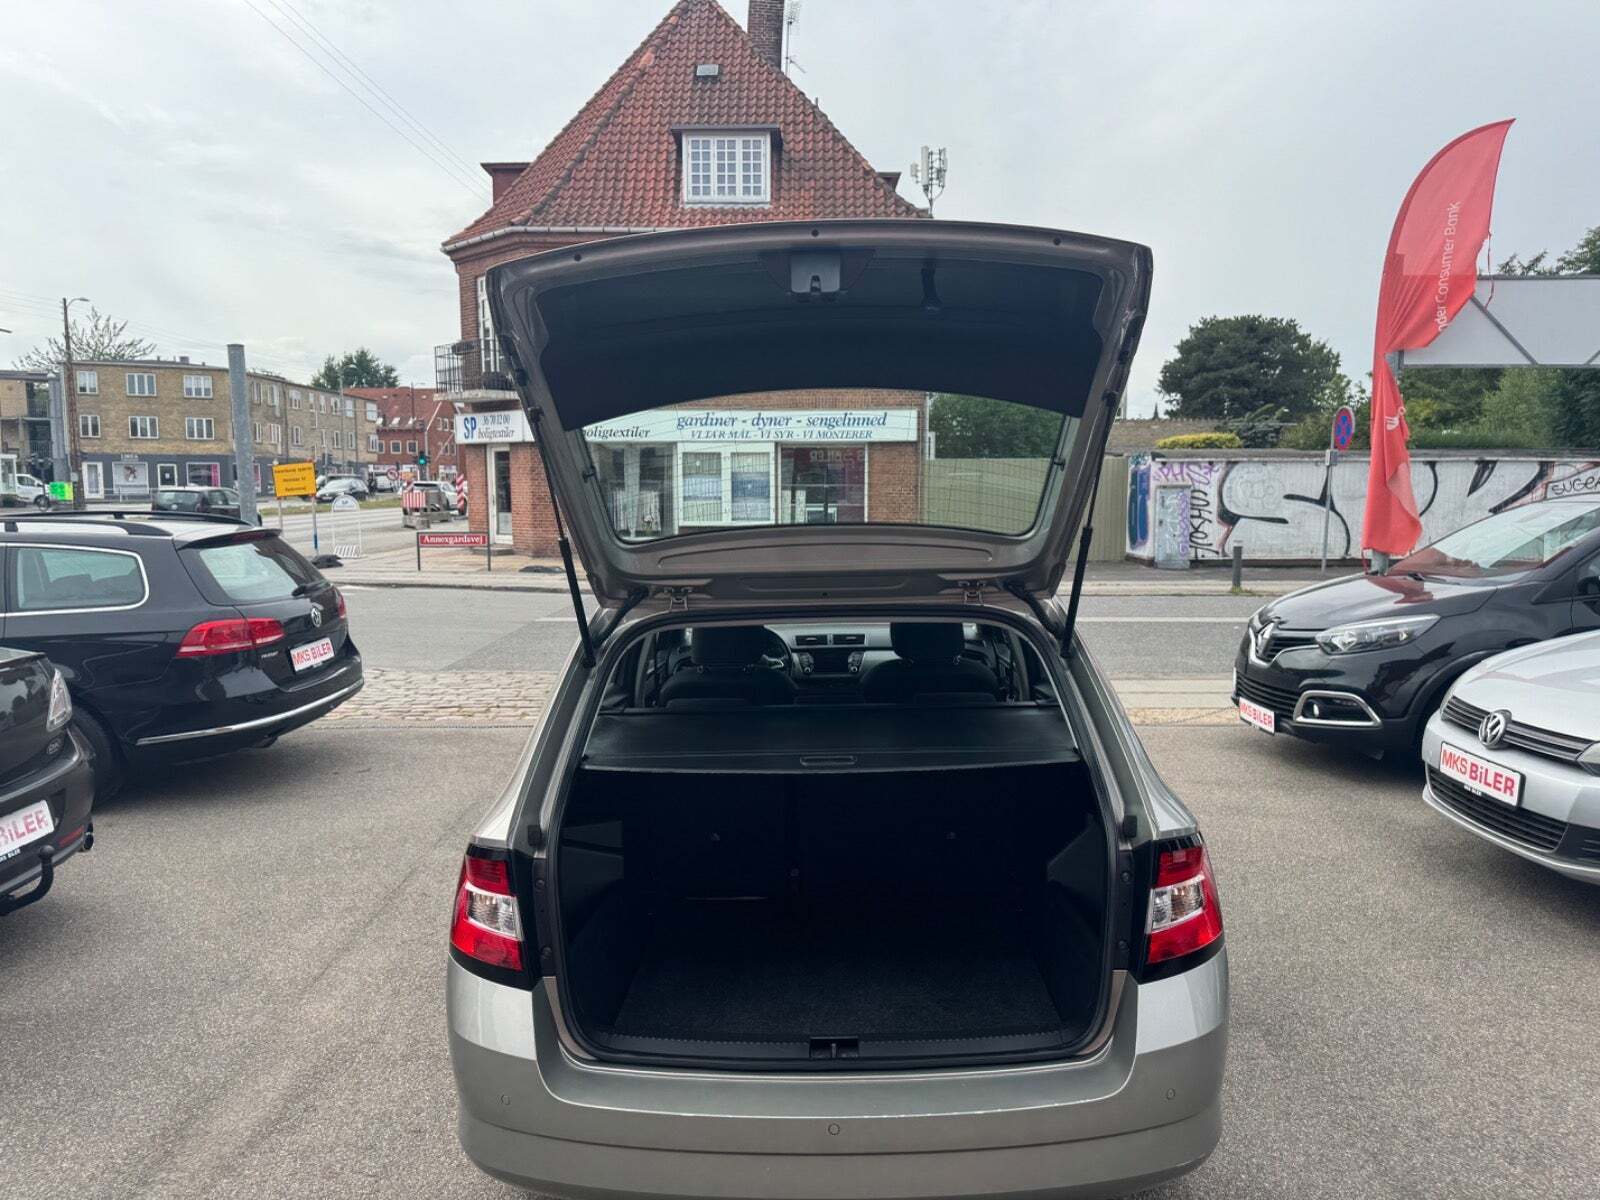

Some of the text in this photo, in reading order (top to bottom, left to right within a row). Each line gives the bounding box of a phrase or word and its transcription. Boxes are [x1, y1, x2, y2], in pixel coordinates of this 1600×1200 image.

[1444, 201, 1461, 236] Bank
[1435, 239, 1455, 303] Consumer
[464, 416, 477, 439] SP
[677, 412, 737, 430] gardiner
[751, 412, 792, 430] dyner
[806, 412, 887, 430] sengelinned
[583, 425, 650, 439] oligtextiler
[774, 430, 793, 439] SYR
[816, 430, 873, 439] MONTERER
[292, 649, 311, 665] MKS
[1442, 749, 1467, 775] MKS
